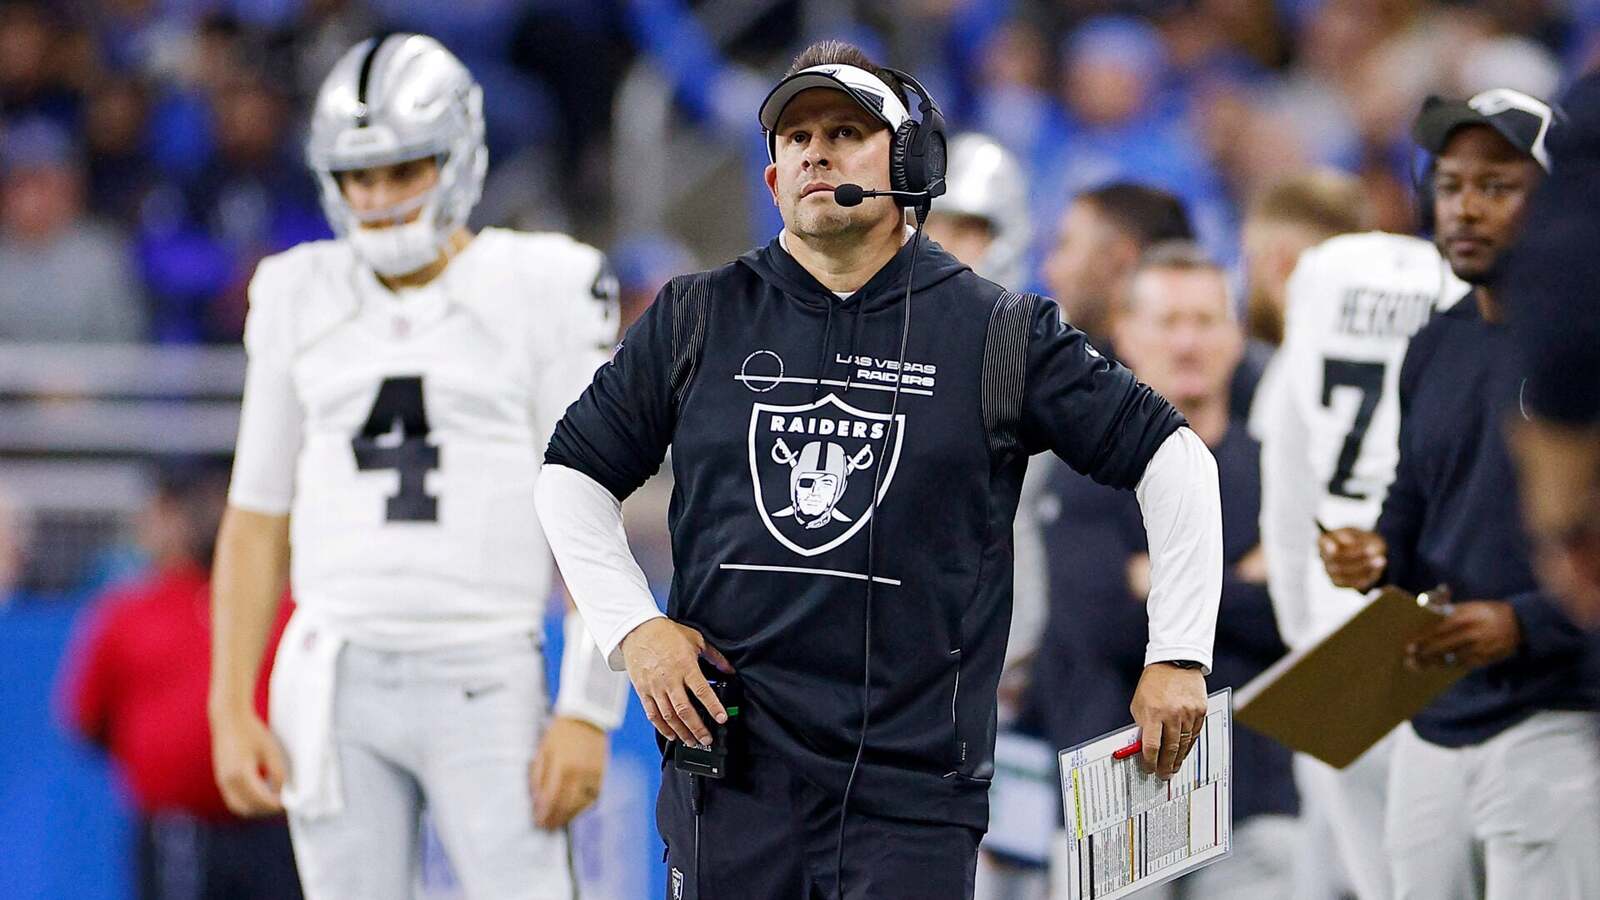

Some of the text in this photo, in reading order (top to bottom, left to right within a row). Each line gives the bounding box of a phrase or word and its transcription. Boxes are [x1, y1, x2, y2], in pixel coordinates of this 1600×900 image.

[836, 353, 937, 375] LAS VEGAS
[857, 369, 935, 387] RAIDERS
[770, 415, 885, 440] RAIDERS
[352, 375, 440, 521] 4
